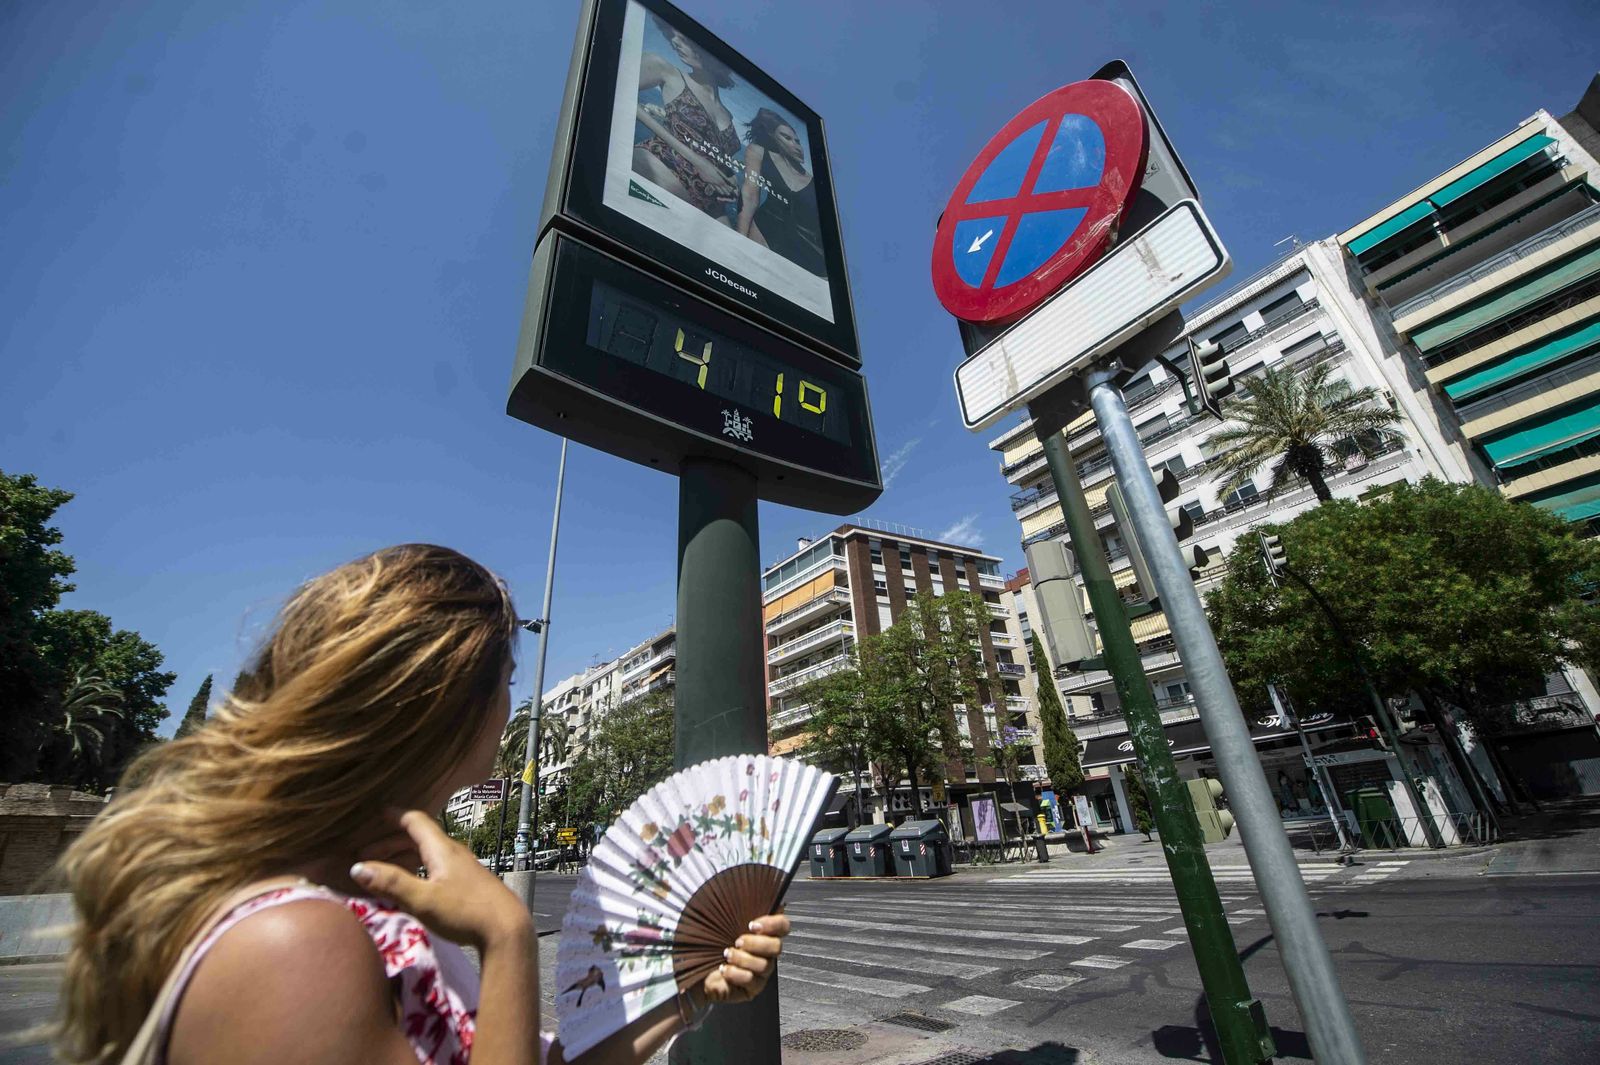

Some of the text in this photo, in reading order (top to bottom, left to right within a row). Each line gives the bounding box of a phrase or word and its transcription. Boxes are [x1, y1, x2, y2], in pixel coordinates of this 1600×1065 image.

[684, 135, 789, 205] VERANOS IGUALES
[703, 140, 772, 187] NO HAY DOS
[705, 268, 758, 299] JCDecaux
